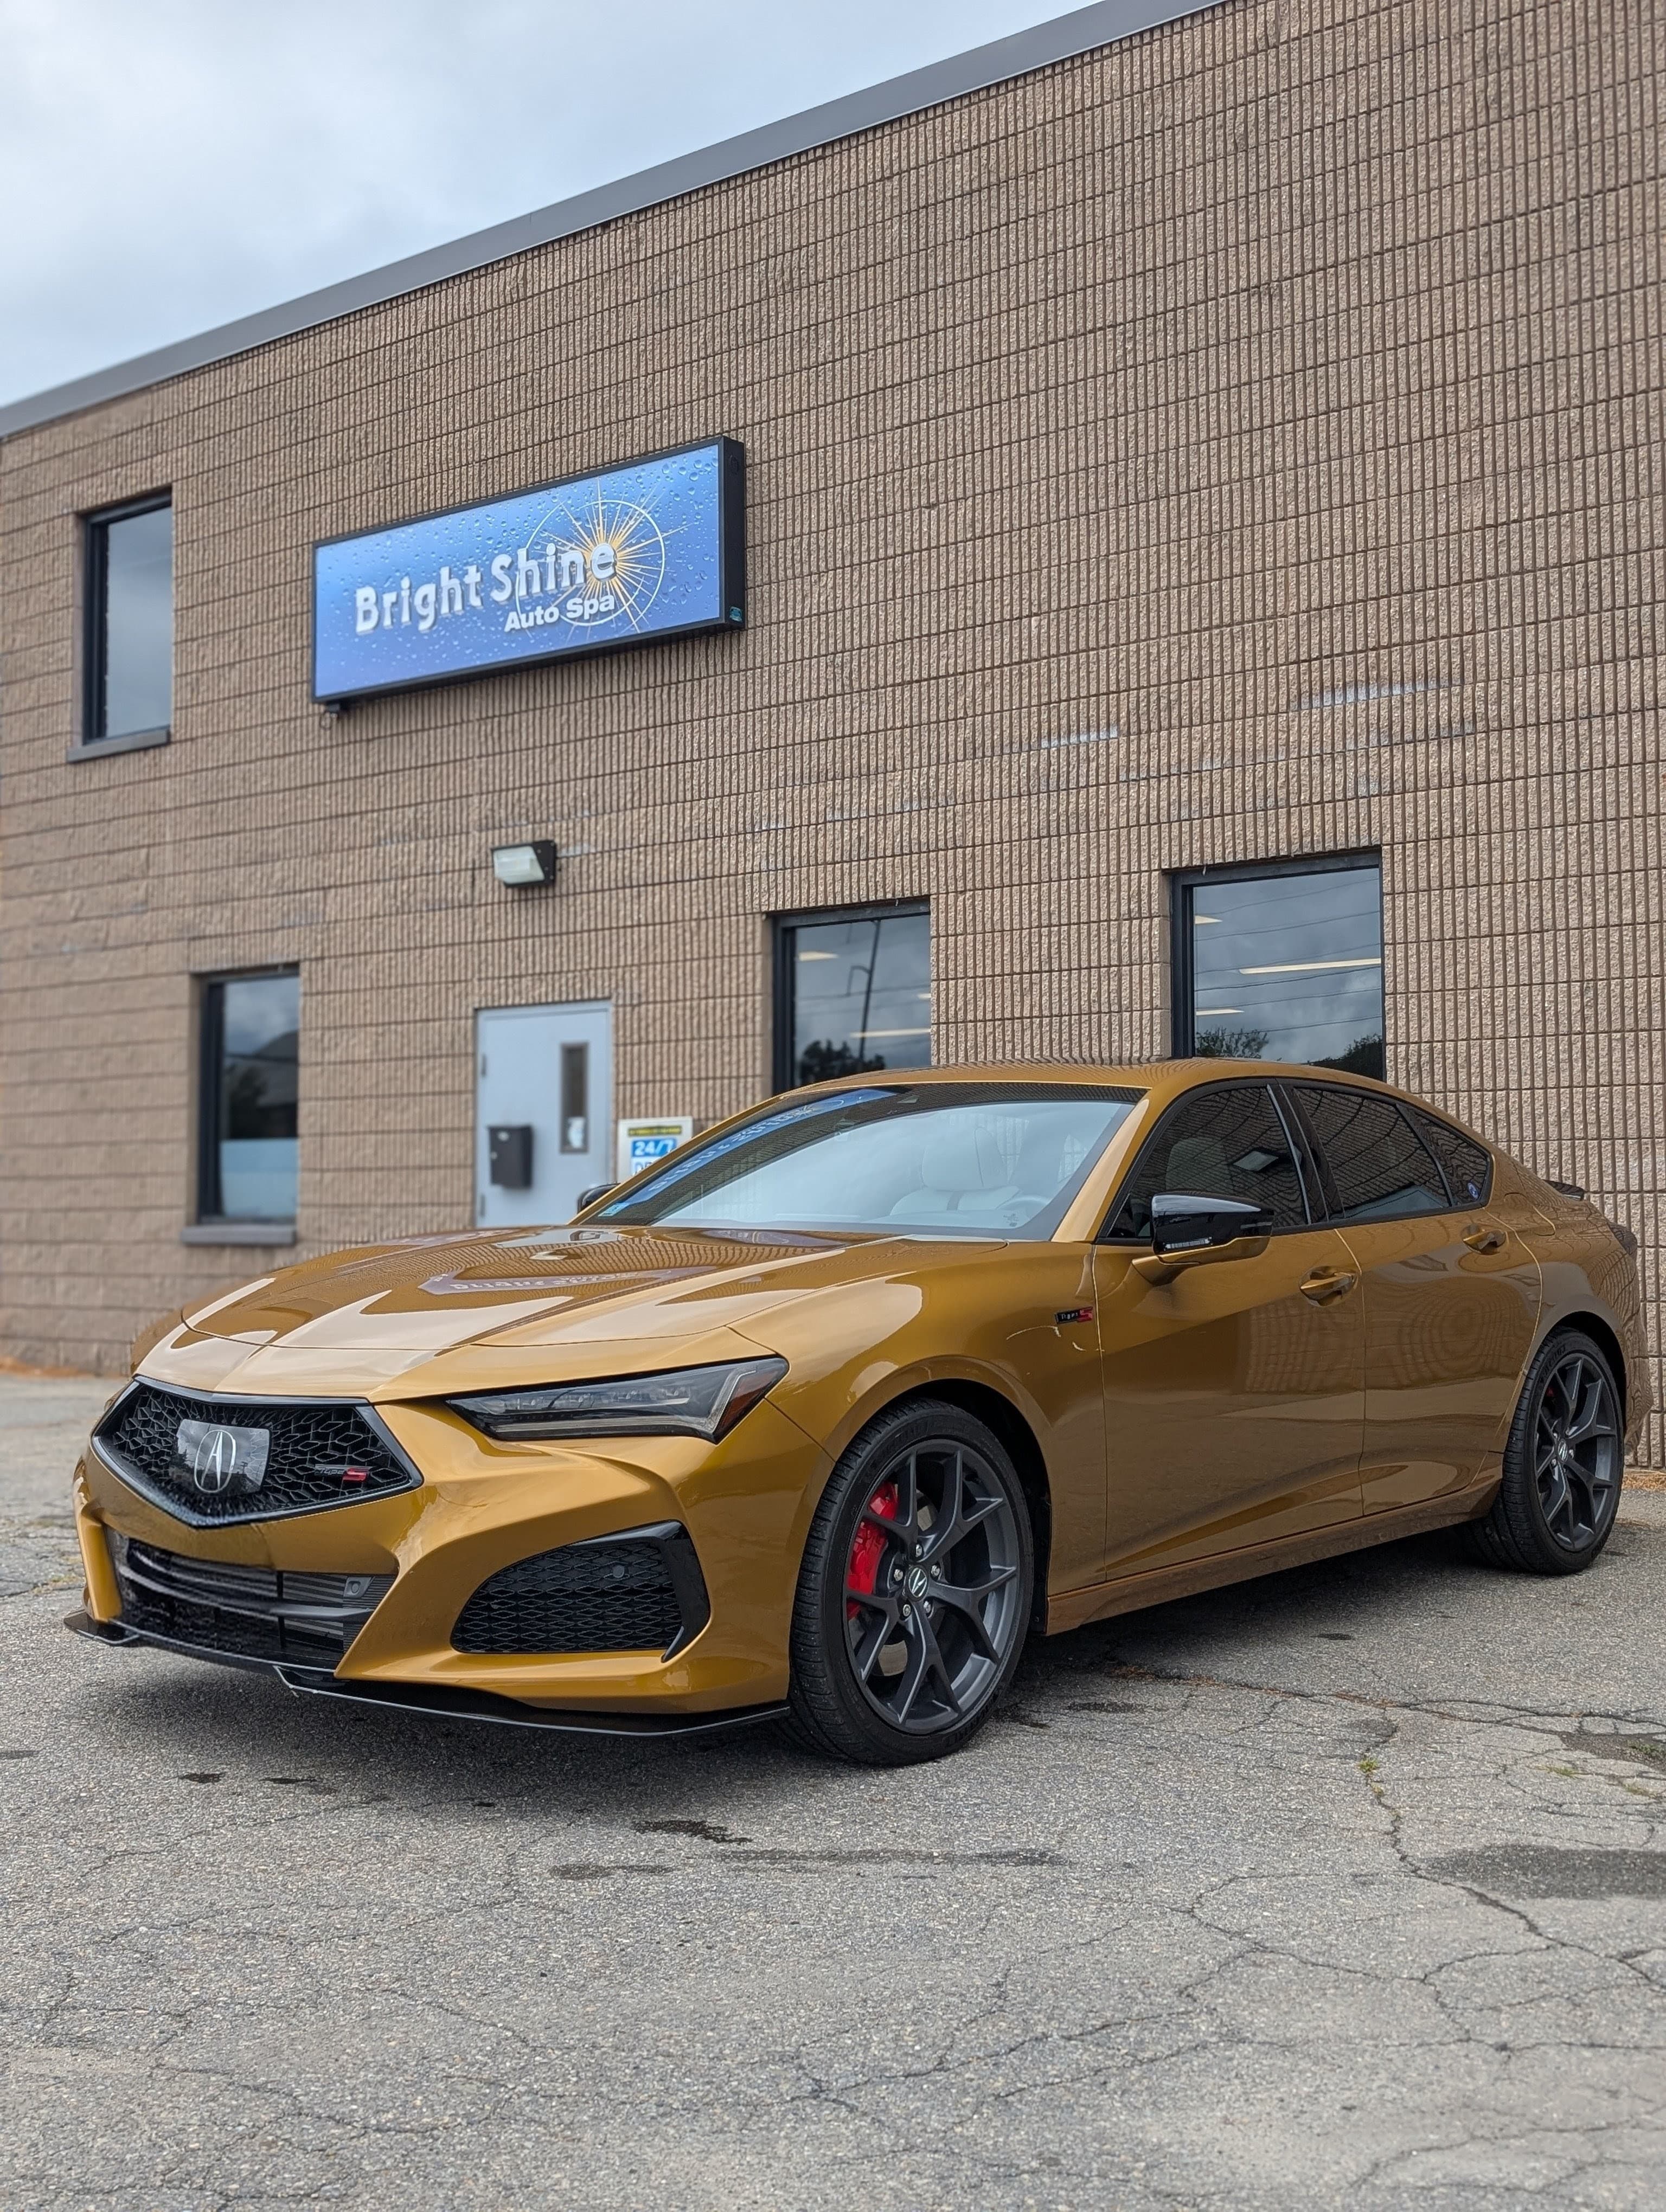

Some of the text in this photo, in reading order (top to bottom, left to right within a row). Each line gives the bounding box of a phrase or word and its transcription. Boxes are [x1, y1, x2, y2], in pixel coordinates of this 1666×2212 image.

[504, 595, 615, 633] Auto Spa
[634, 1139, 674, 1156] 24/7
